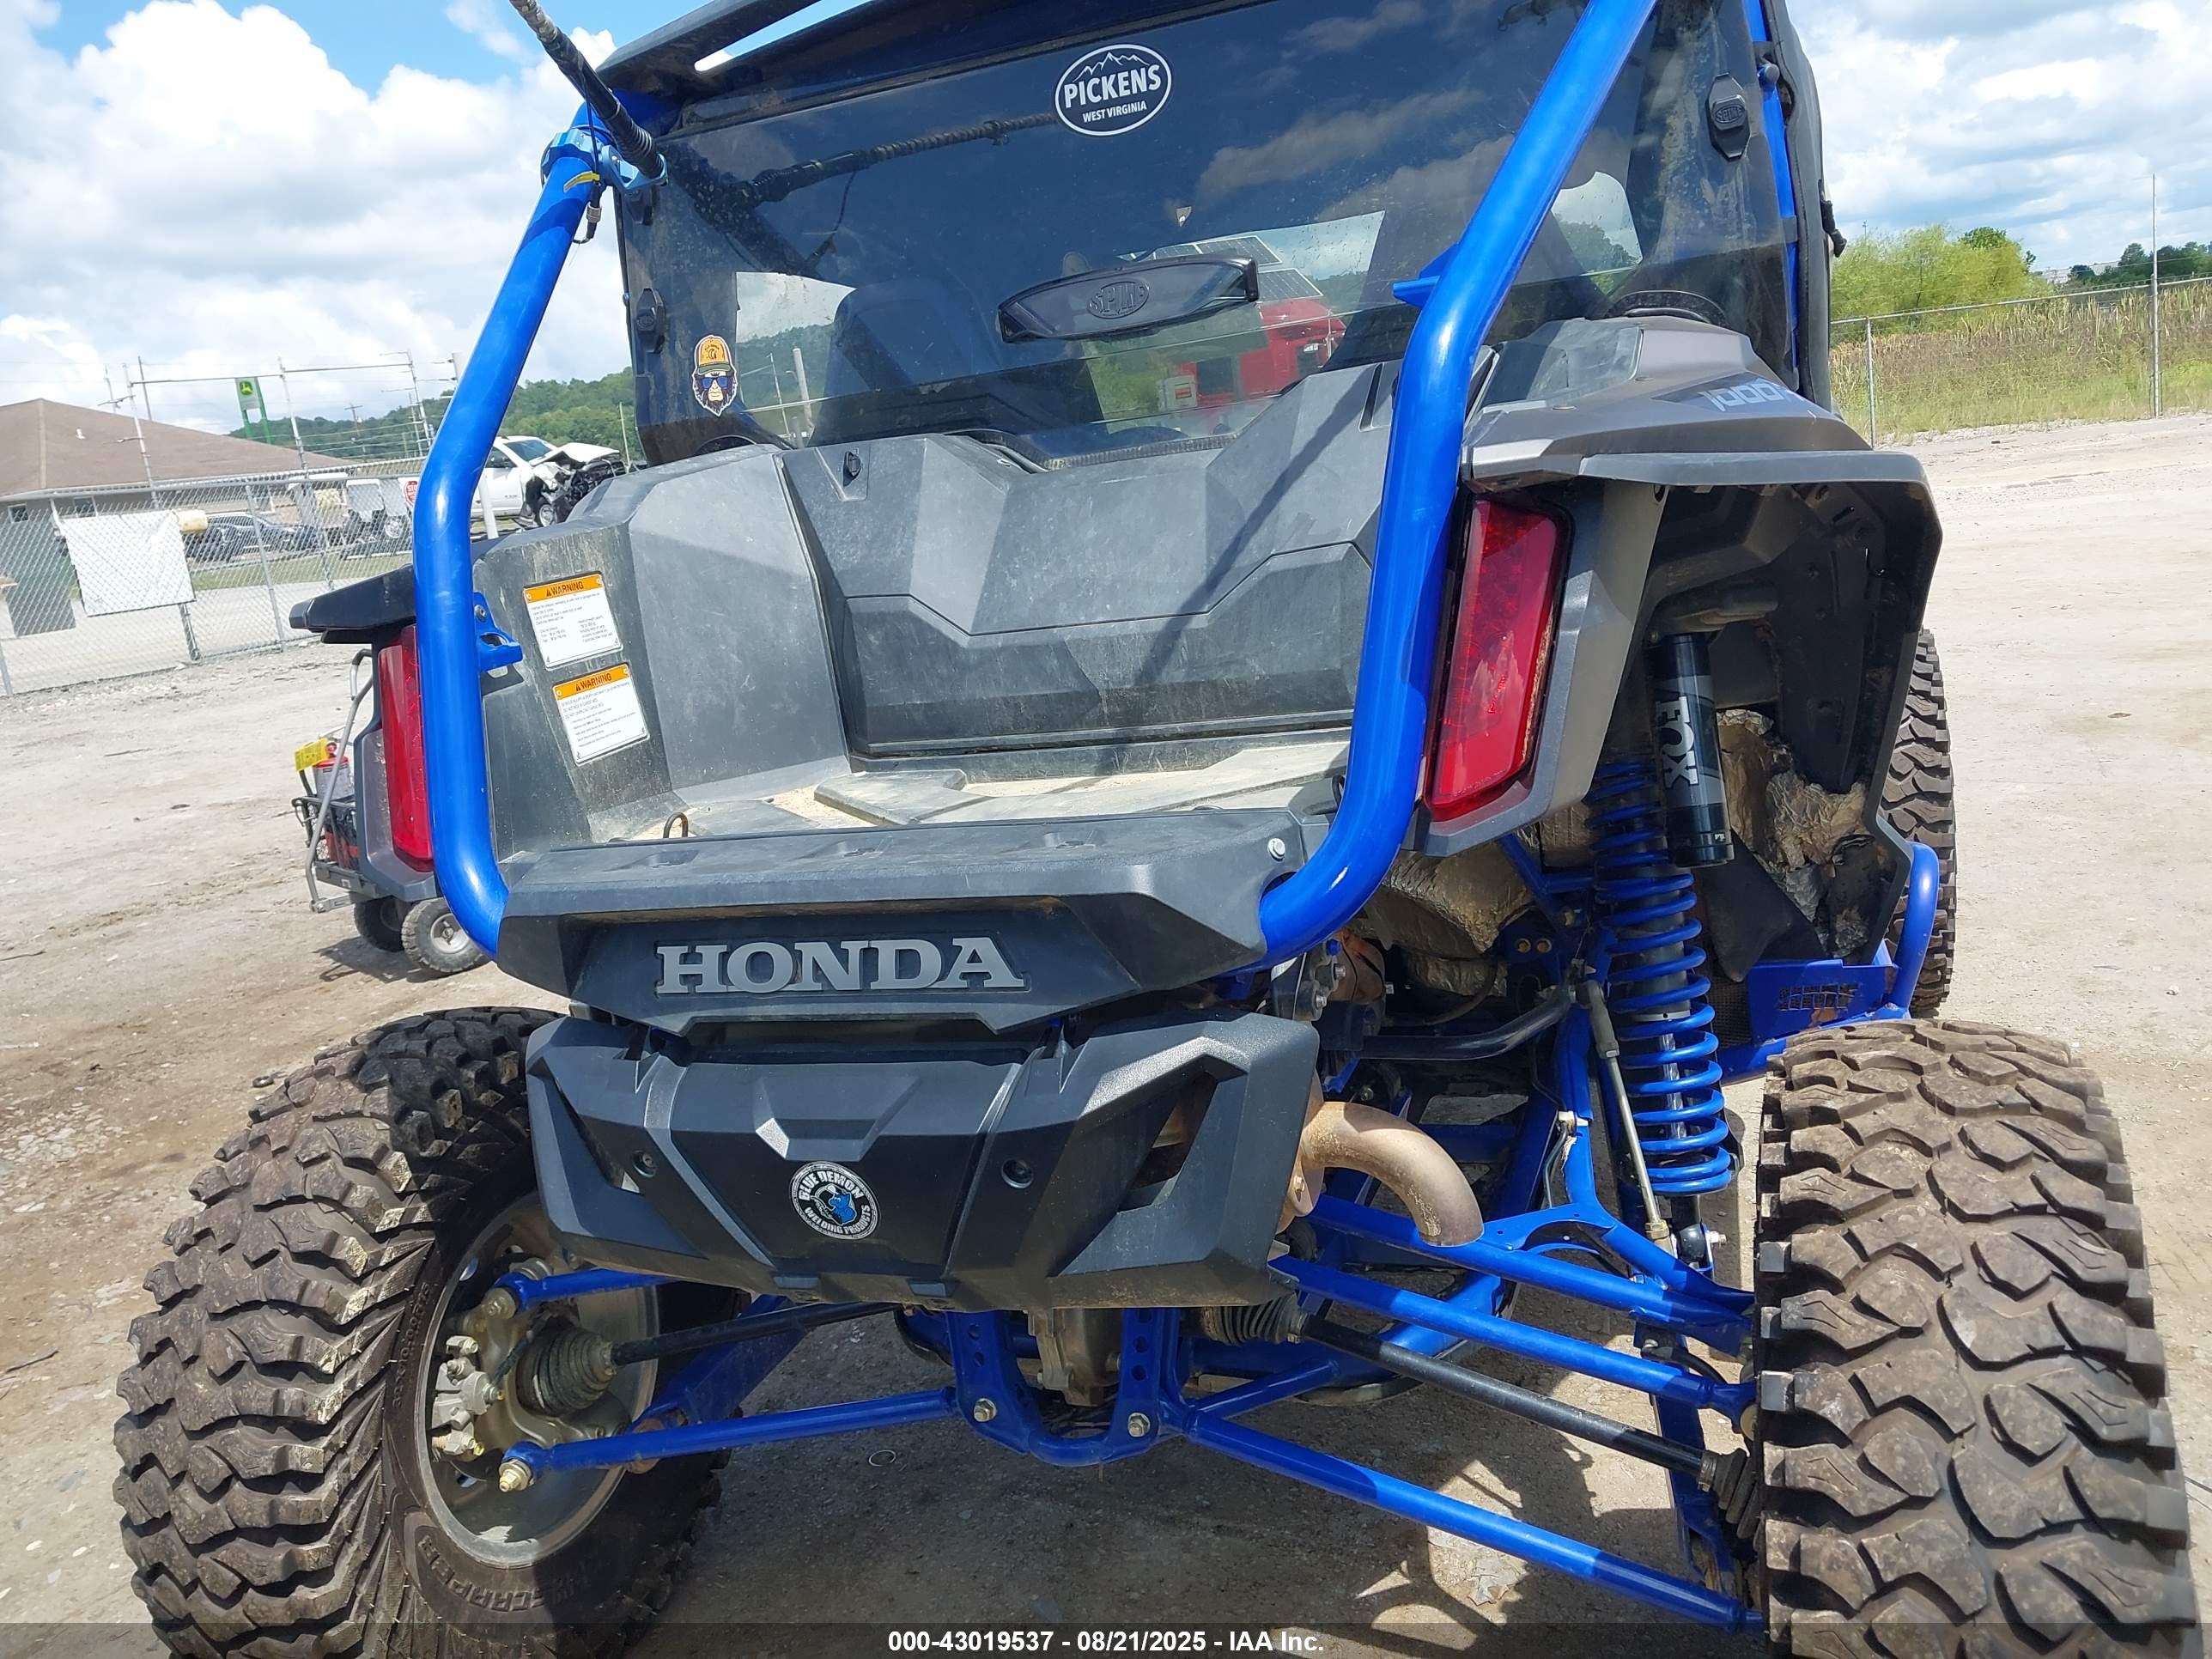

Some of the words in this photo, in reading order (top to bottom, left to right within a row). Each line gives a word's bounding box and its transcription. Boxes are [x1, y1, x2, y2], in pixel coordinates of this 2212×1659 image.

[1064, 64, 1162, 108] PICKENS
[1082, 109, 1106, 123] WEST
[1106, 100, 1147, 118] VIRGINIA
[551, 580, 584, 595] WARNING
[580, 672, 612, 690] WARNING
[1656, 696, 1698, 788] FOX
[656, 937, 1024, 994] HONDA
[799, 1172, 819, 1201] BLUE
[817, 1170, 865, 1199] DEMON
[804, 1206, 843, 1234] WELDING
[843, 1205, 871, 1234] PRODUCTS
